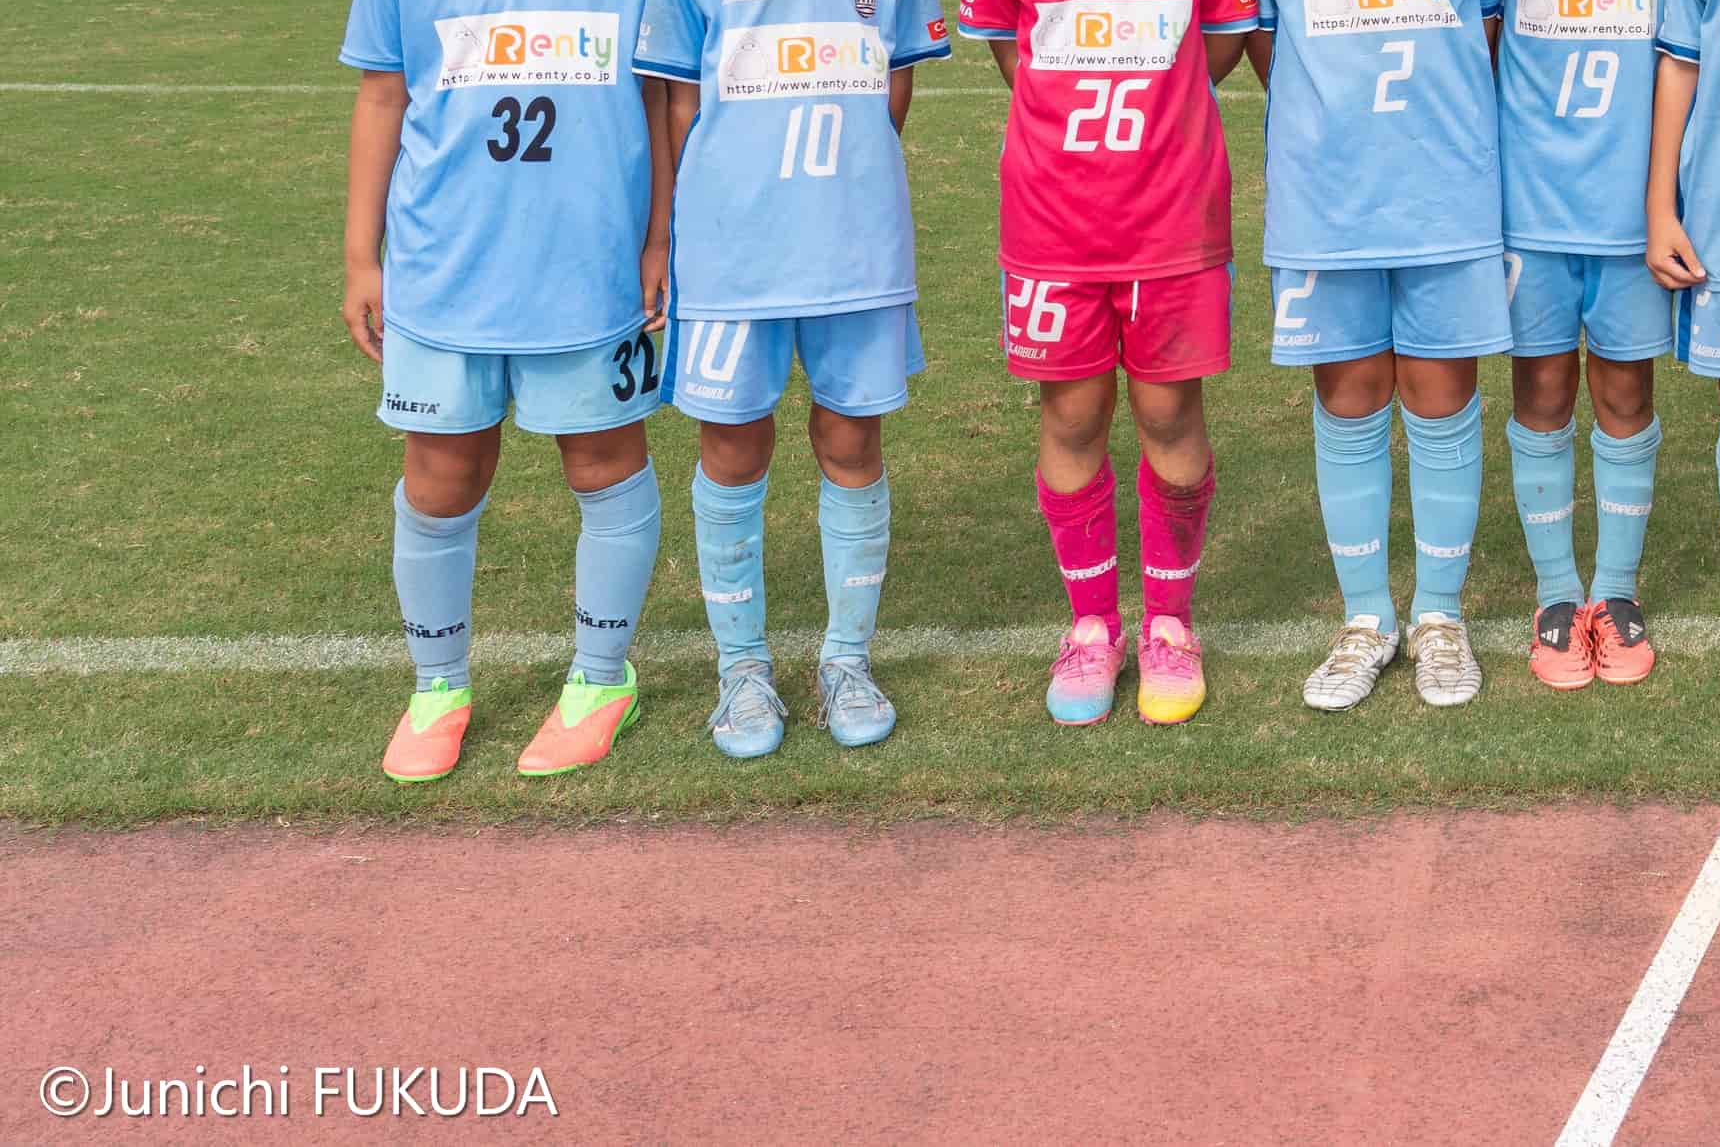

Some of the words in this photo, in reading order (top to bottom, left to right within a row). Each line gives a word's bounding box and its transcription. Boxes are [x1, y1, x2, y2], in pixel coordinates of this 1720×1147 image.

[484, 24, 612, 68] Renty
[778, 37, 886, 75] Renty
[1373, 41, 1415, 112] 2
[1063, 79, 1151, 151] 26
[1554, 51, 1620, 118] 19
[487, 96, 557, 162] 32
[779, 104, 843, 179] 10
[1008, 274, 1069, 342] 26
[612, 331, 659, 402] 32
[685, 320, 750, 382] 10
[386, 399, 439, 415] THLETA
